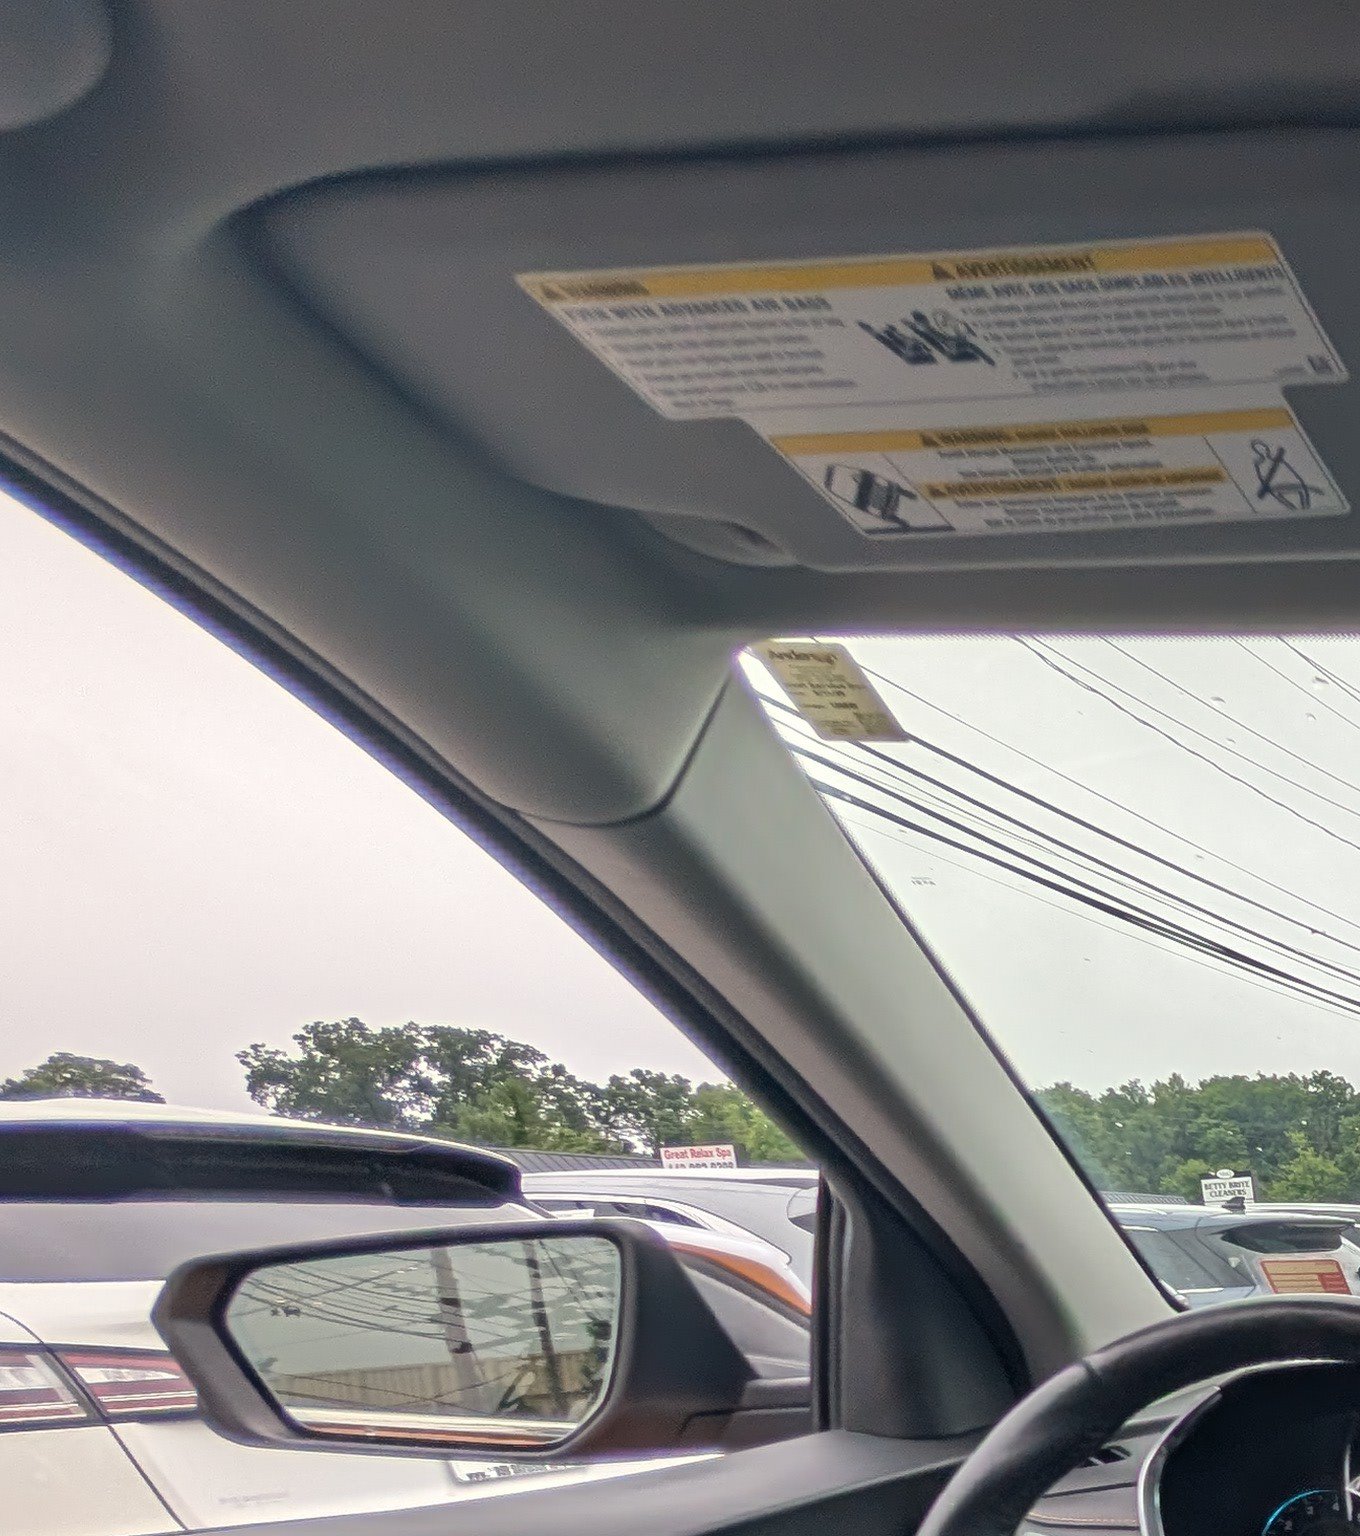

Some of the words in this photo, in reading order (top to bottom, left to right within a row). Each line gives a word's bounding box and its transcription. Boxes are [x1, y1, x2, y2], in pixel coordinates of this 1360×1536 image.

[663, 1149, 690, 1160] Great
[689, 1148, 714, 1159] Relax
[715, 1147, 732, 1160] Spa
